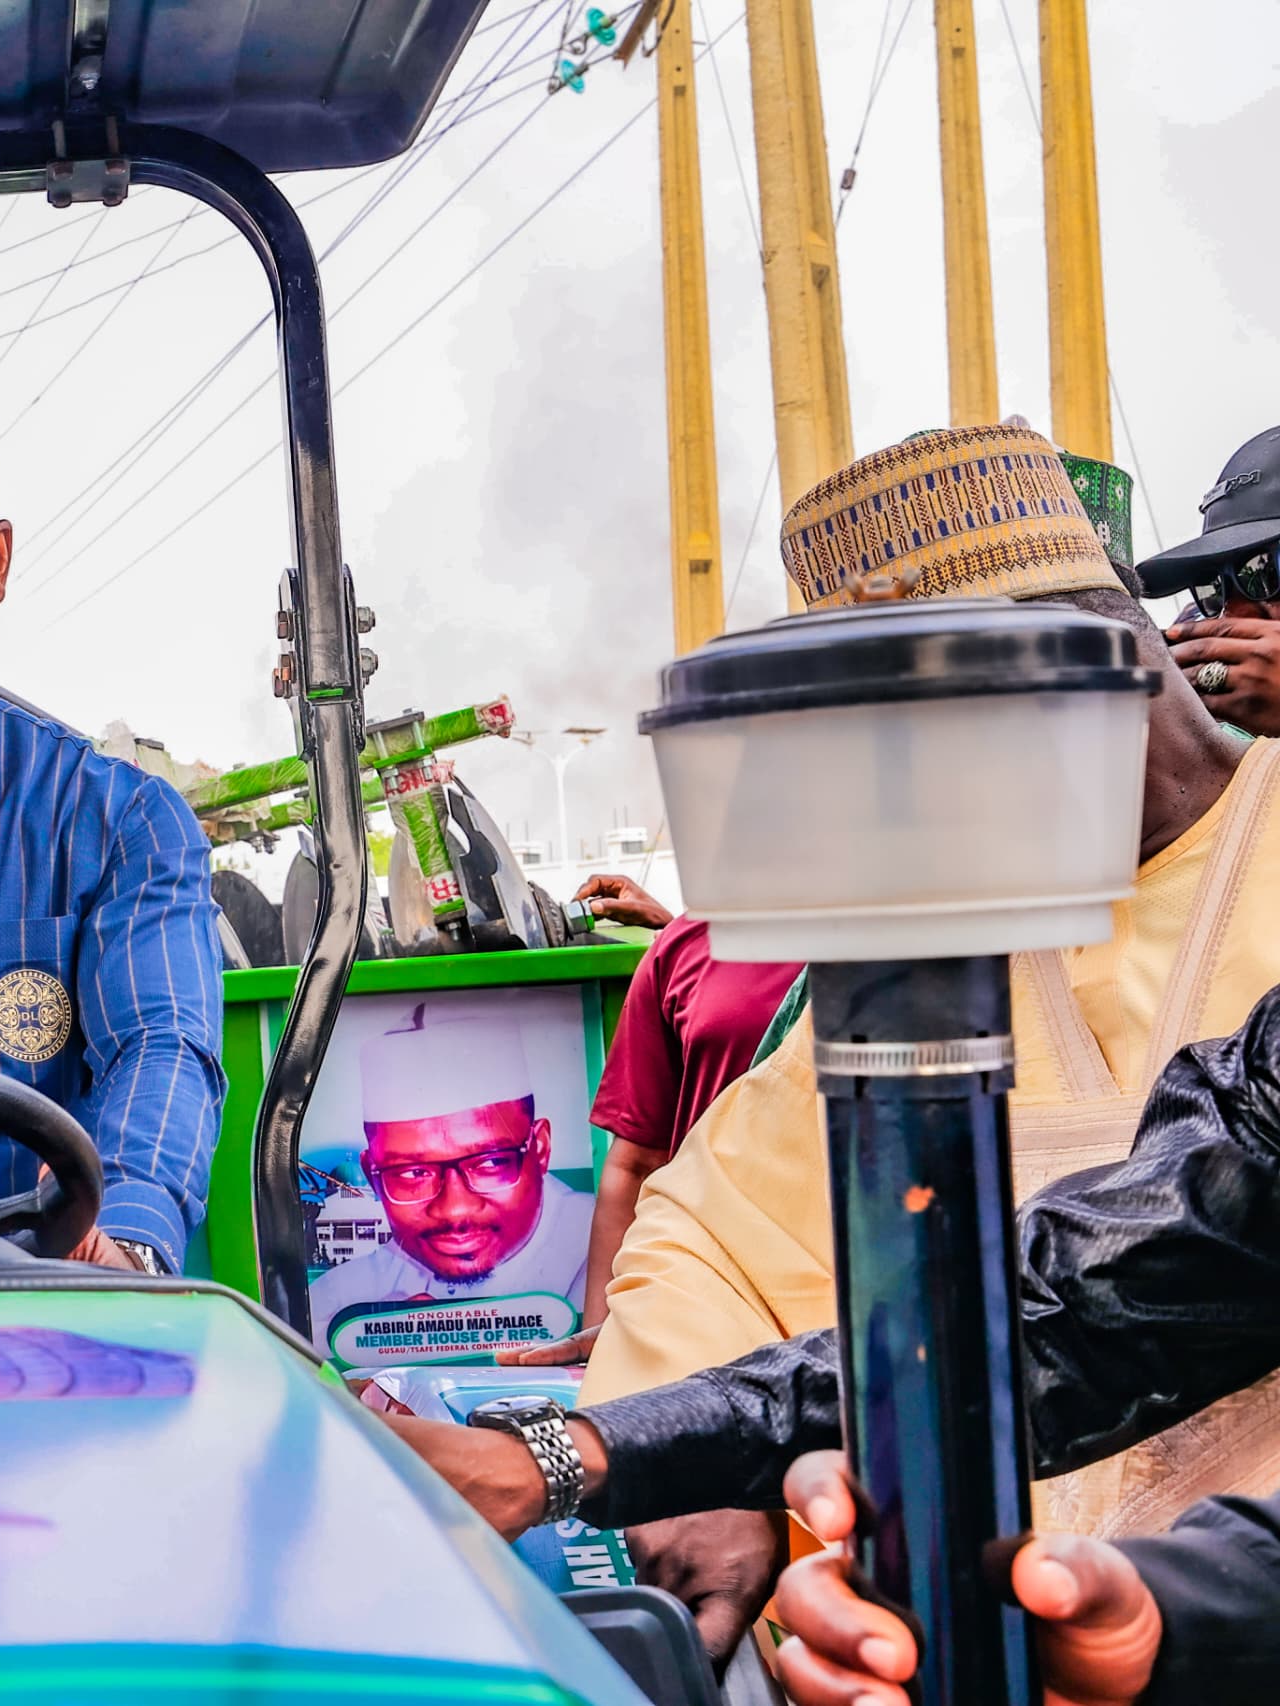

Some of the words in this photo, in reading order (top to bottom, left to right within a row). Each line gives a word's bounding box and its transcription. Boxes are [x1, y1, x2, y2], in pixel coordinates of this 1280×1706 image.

[21, 1011, 39, 1021] DL
[408, 1308, 498, 1320] HONOURABLE
[364, 1321, 414, 1335] KABIRU
[416, 1318, 464, 1333] AMADU
[466, 1317, 492, 1331] MAI
[495, 1315, 543, 1329] PALACE
[356, 1334, 423, 1348] MEMBER
[427, 1331, 480, 1345] HOUSE
[484, 1330, 504, 1342] OF
[507, 1327, 554, 1341] REPS.
[378, 1345, 433, 1354] GUSAU/TSAFE
[436, 1344, 469, 1352] FEDERAL
